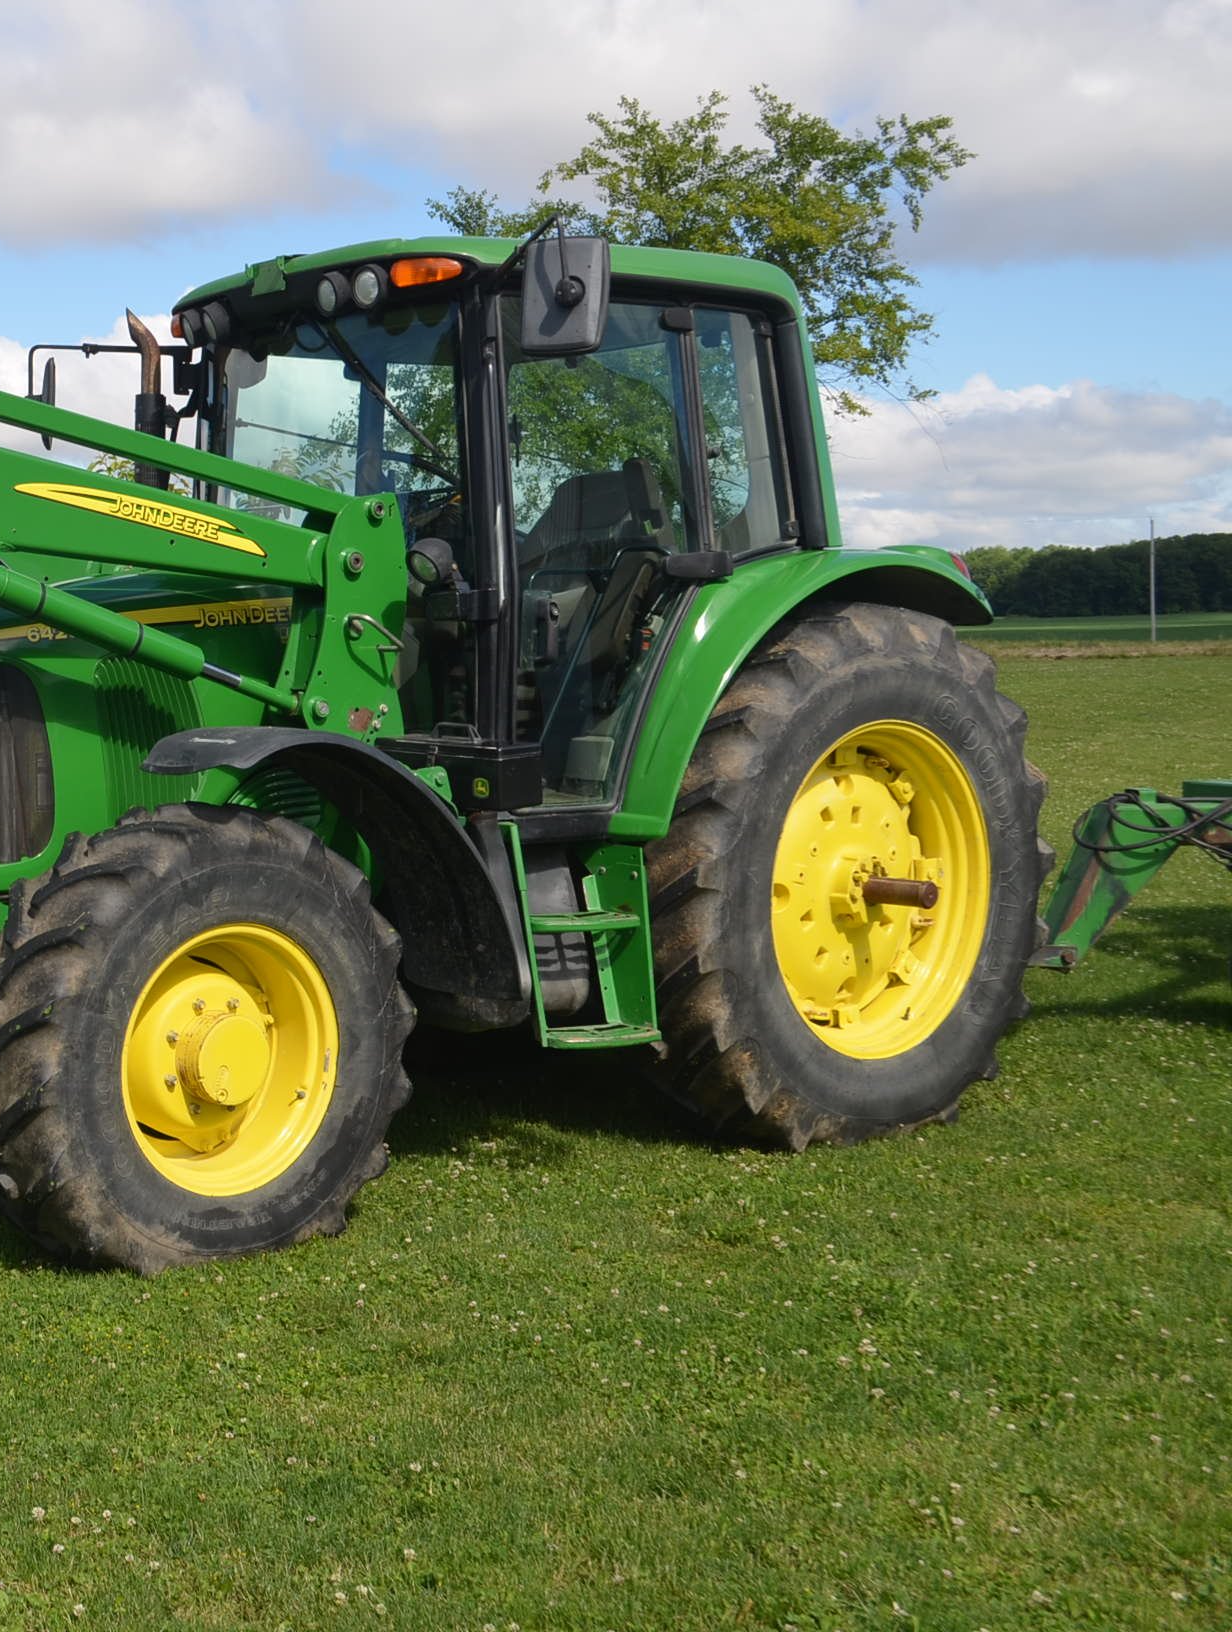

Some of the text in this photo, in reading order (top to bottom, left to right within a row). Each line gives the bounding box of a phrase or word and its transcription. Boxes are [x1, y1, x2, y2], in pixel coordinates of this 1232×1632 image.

[110, 496, 220, 541] JOHN DEERE
[194, 607, 248, 629] JOHN
[27, 626, 75, 643] 642
